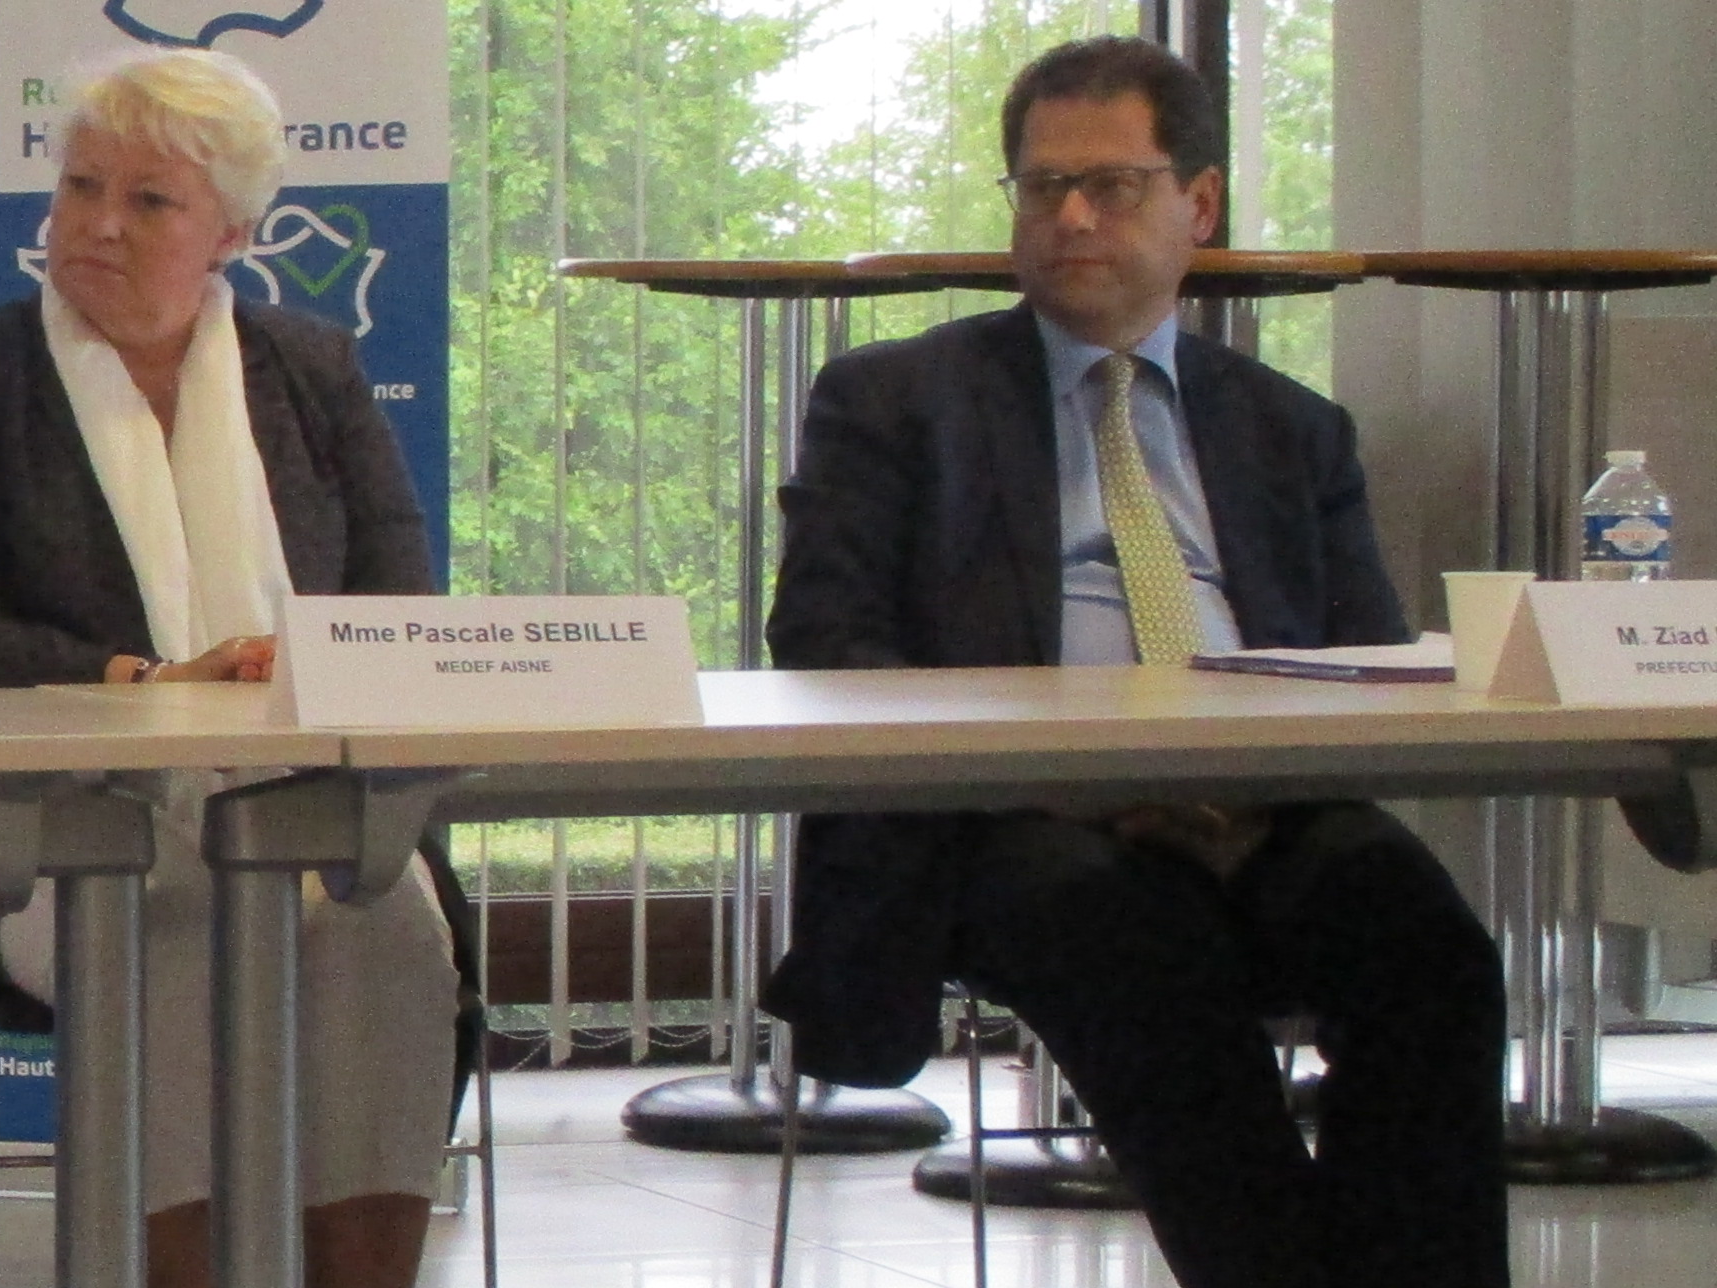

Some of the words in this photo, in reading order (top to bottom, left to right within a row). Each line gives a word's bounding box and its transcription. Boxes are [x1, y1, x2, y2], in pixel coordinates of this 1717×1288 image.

[330, 623, 396, 643] Mme
[405, 621, 515, 643] Pascale
[524, 621, 648, 642] SEBILLE
[1653, 625, 1710, 645] Ziad
[435, 660, 495, 673] MEDEF
[500, 659, 553, 673] AISNE
